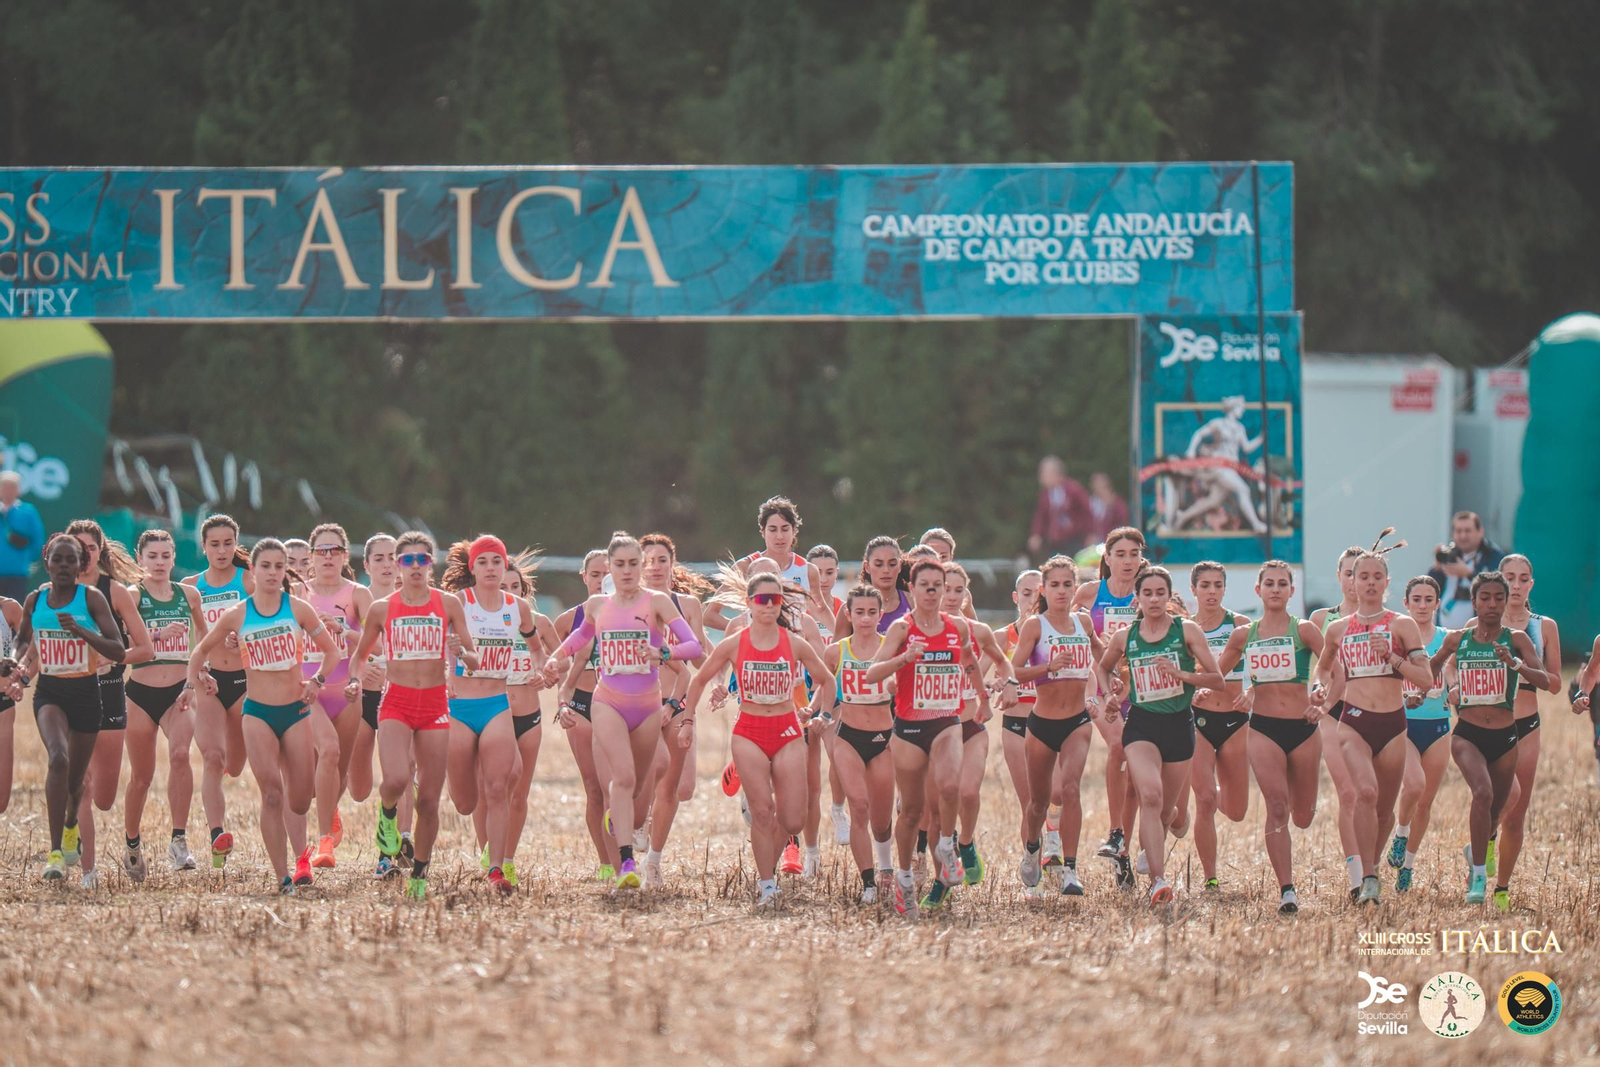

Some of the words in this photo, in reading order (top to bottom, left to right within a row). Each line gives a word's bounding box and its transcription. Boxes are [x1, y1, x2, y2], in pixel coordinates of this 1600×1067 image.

[152, 167, 680, 290] ITÁLICA
[862, 214, 1050, 237] CAMPEONATO
[1053, 213, 1090, 236] DE
[1092, 208, 1255, 236] ANDALUCÍA
[923, 238, 961, 261] DE
[962, 237, 1063, 261] CAMPO
[1066, 237, 1089, 260] A
[984, 262, 1040, 285] POR
[1042, 261, 1140, 284] CLUBES
[0, 288, 79, 316] NTRY
[246, 633, 296, 667] ROMERO
[392, 625, 441, 651] MACHADO
[39, 639, 86, 665] BIWOT
[935, 652, 951, 661] BM
[1250, 653, 1291, 669] 5005
[743, 671, 790, 695] BARREIRO
[915, 673, 960, 701] ROBLES
[1461, 669, 1505, 696] AMEBAW
